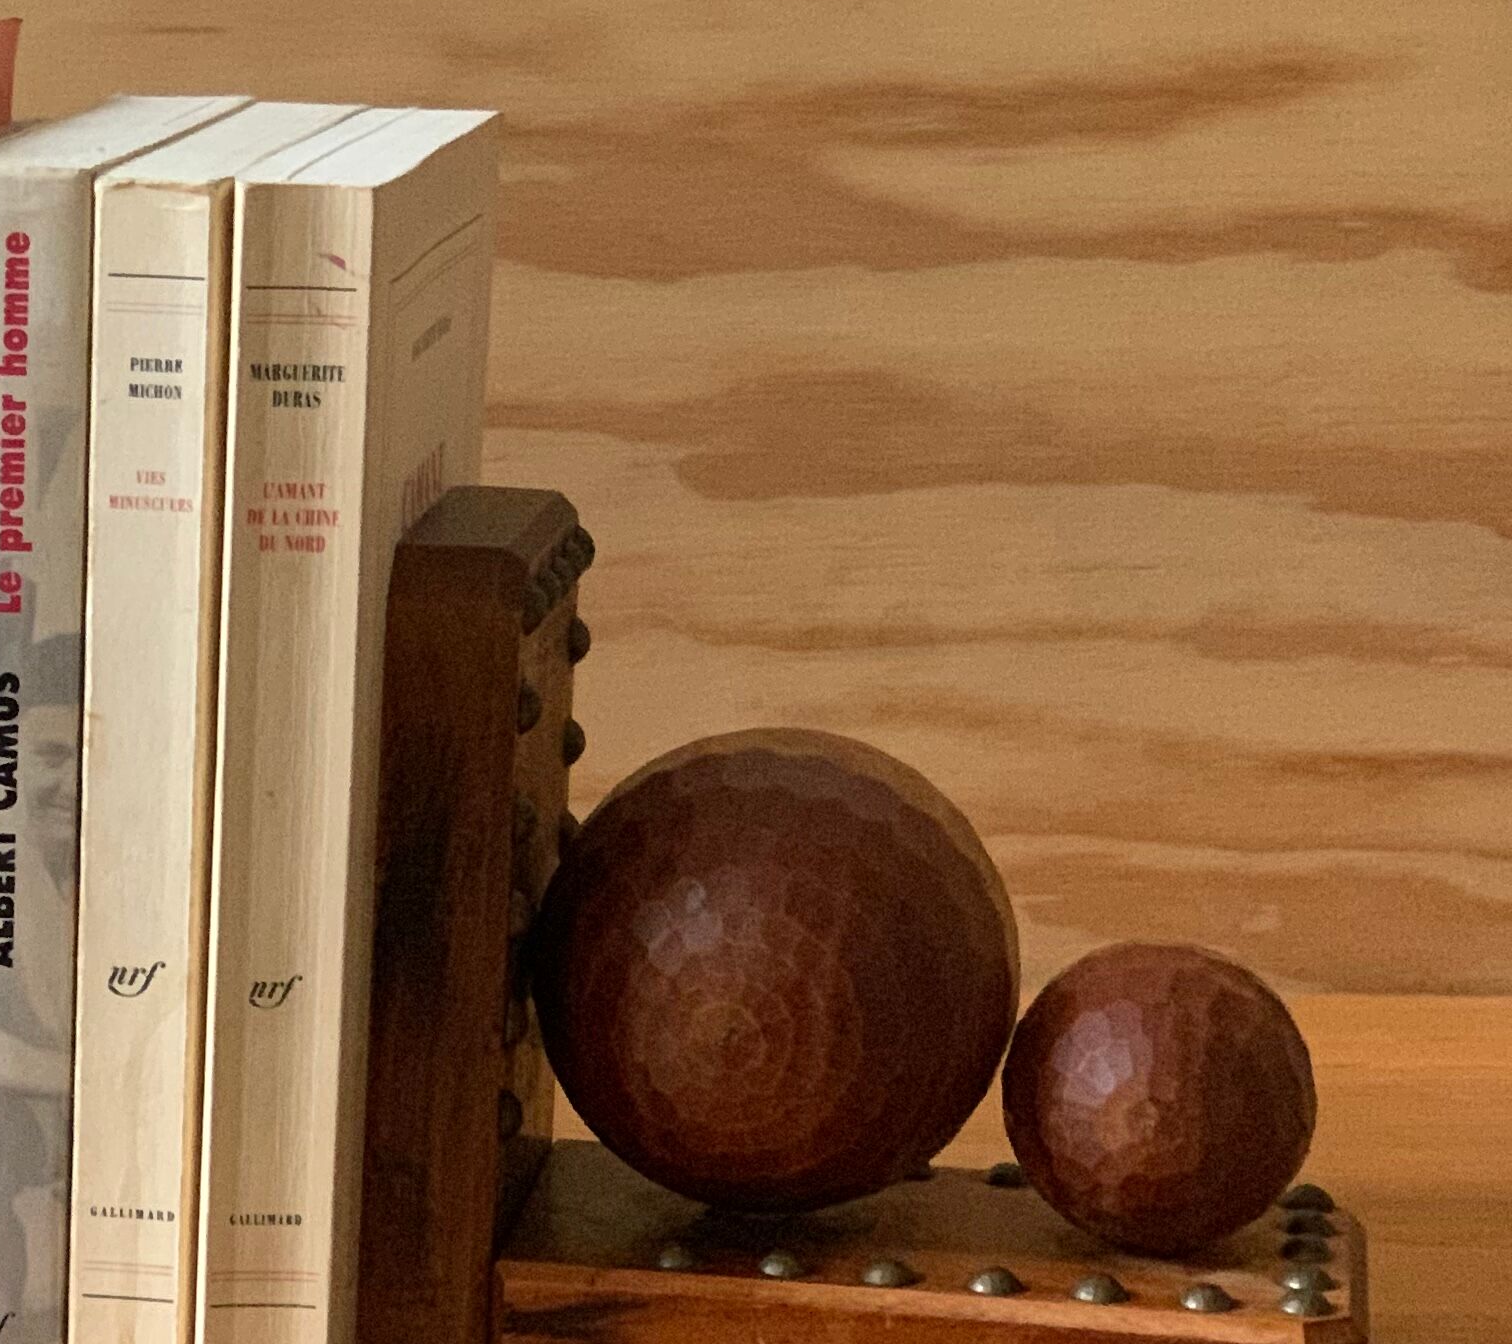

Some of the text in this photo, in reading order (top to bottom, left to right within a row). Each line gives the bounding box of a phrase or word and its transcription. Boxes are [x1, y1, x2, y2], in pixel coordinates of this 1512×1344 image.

[129, 356, 183, 374] PIERRE
[250, 363, 346, 383] MARGUERITE
[128, 383, 182, 400] MICHON
[271, 390, 322, 408] DURAS
[135, 469, 166, 486] VIES
[262, 482, 327, 500] L'AMANT
[108, 494, 194, 513] MINUSCULES
[246, 508, 340, 527] DE LA CHINE
[258, 534, 326, 554] DU NORD
[107, 960, 167, 998] nrf
[248, 974, 304, 1009] nrf
[89, 1207, 176, 1222] GALLIMARD
[229, 1213, 303, 1227] GALLIMARD
